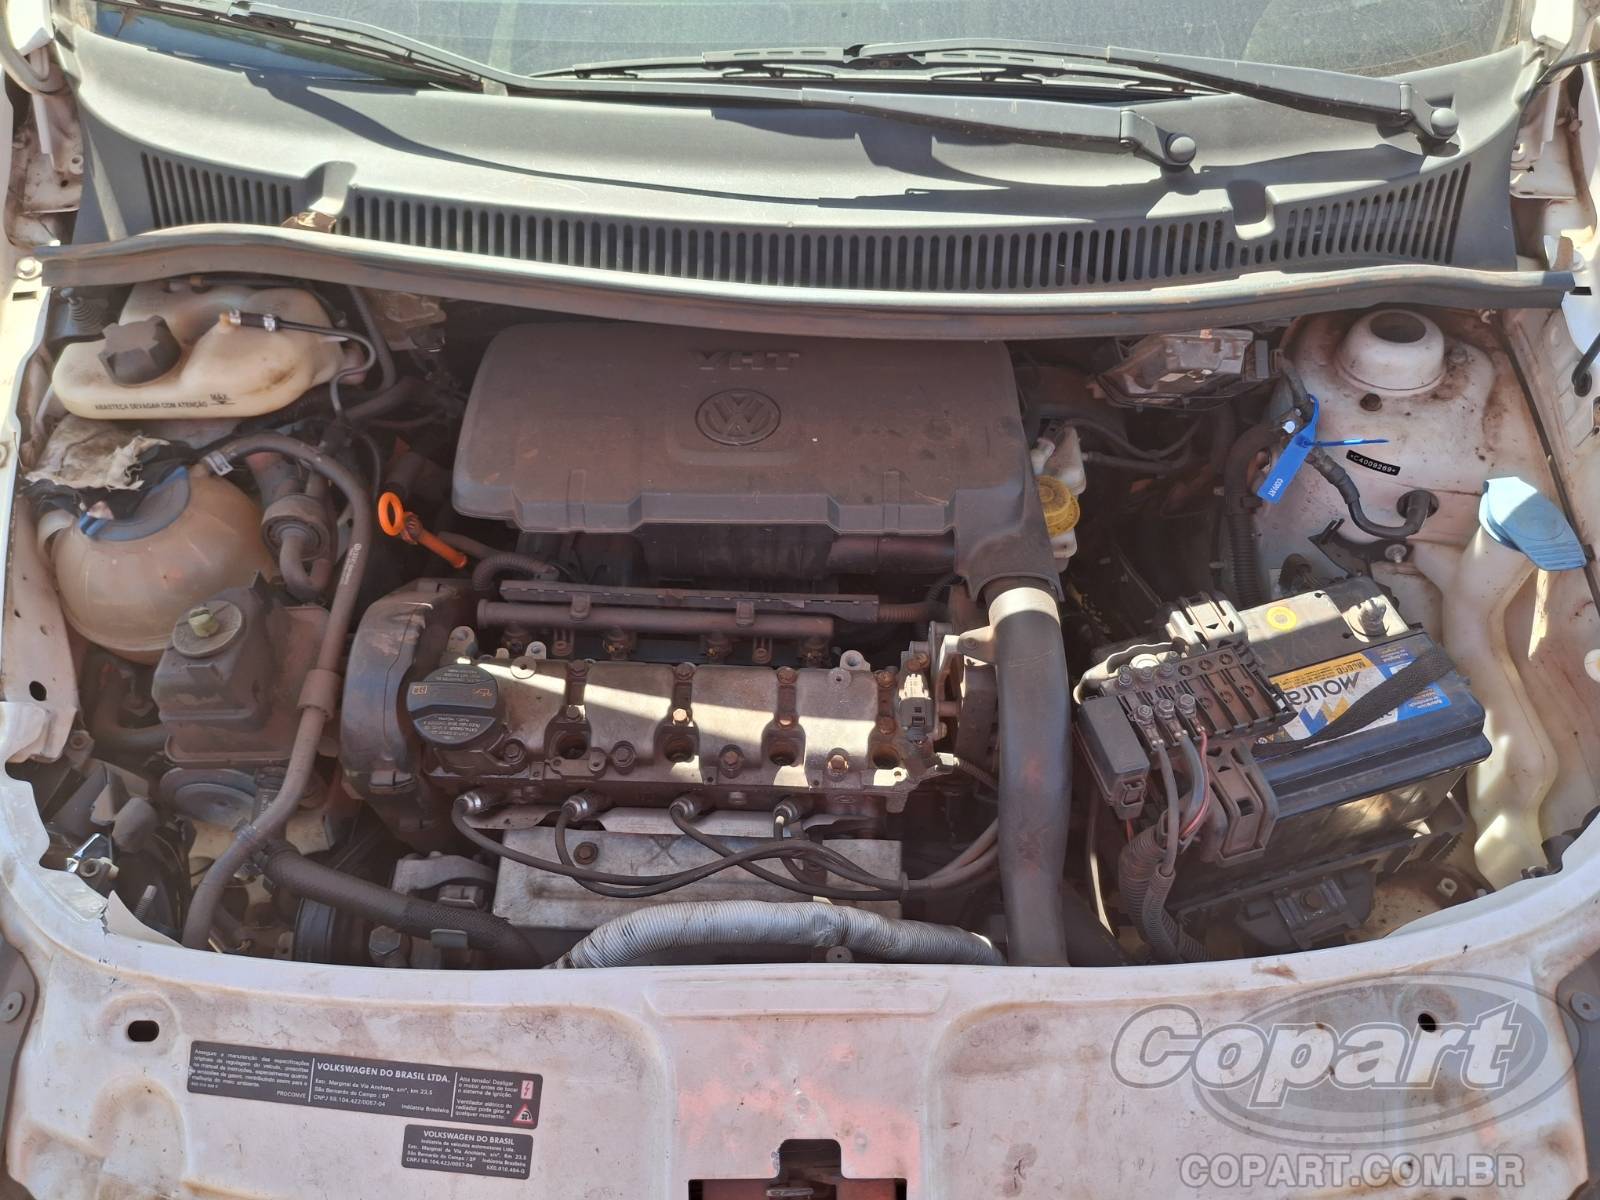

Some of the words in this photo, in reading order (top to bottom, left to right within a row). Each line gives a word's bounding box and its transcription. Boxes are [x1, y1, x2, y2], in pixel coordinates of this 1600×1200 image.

[1285, 671, 1360, 706] Moura
[317, 1062, 379, 1076] VOLKSWAGEN
[380, 1069, 394, 1077] DO
[395, 1070, 426, 1081] BRASIL
[427, 1074, 451, 1083] LTDA.
[329, 1080, 351, 1088] Marginal
[424, 1130, 475, 1141] VOLKSWAGEN
[490, 1137, 515, 1145] BRASIL
